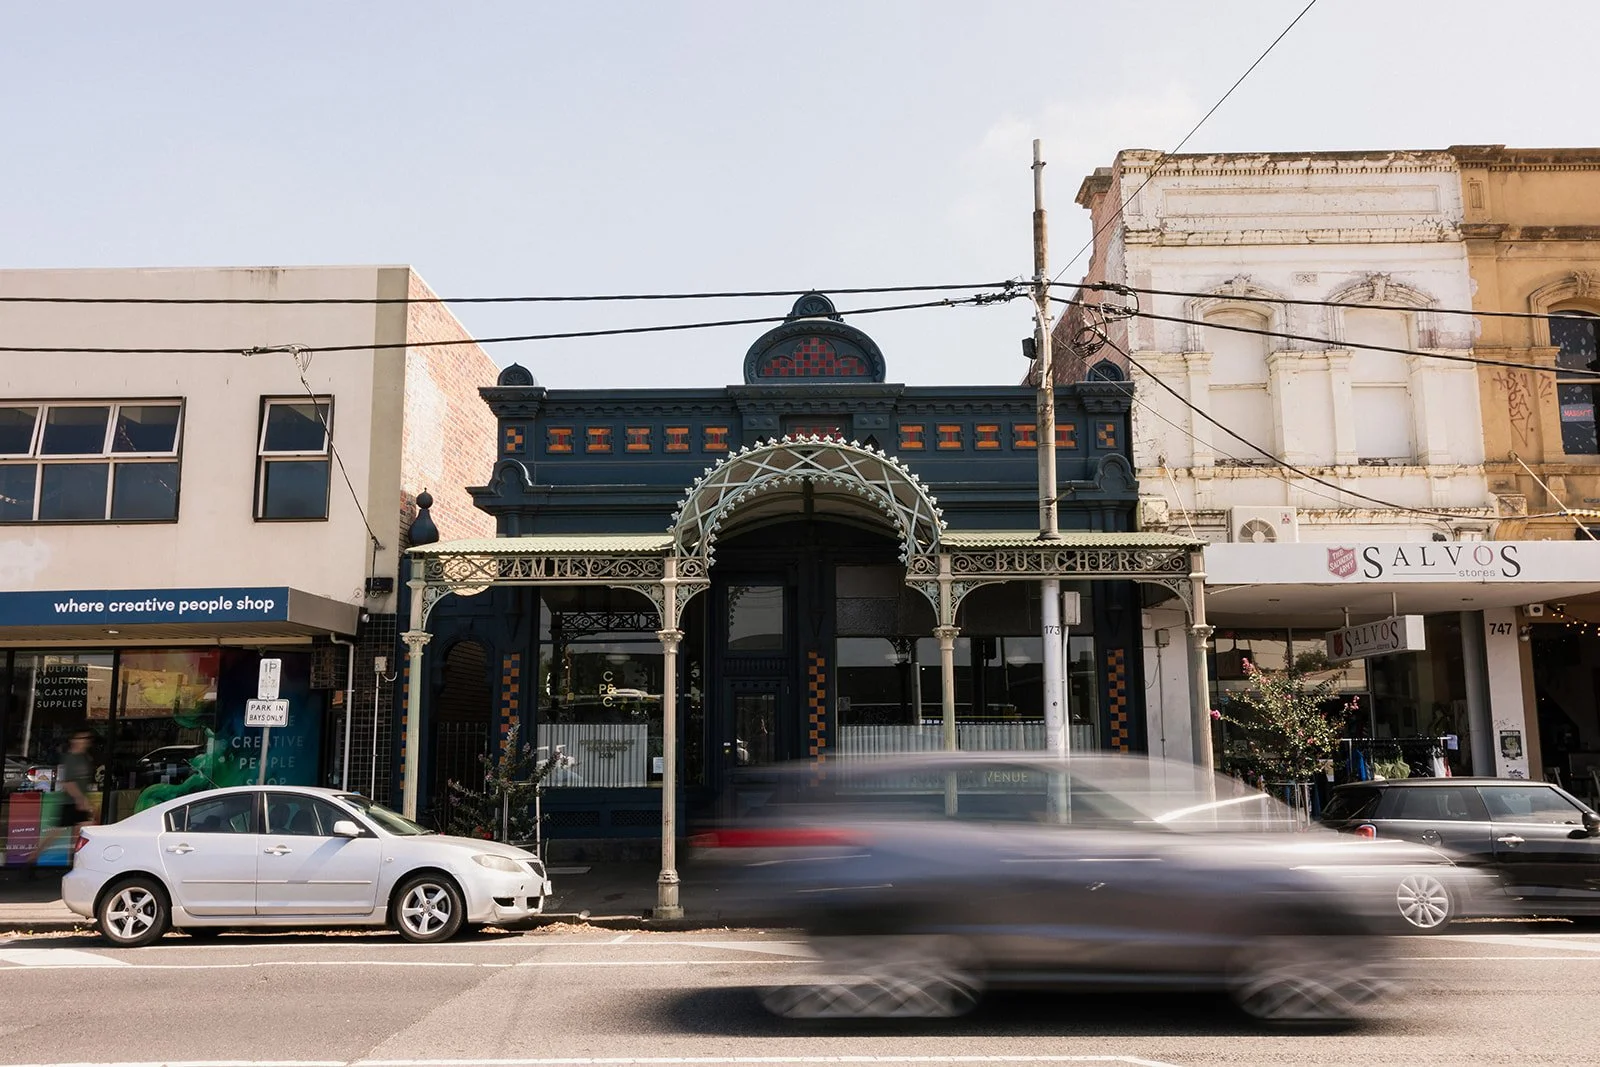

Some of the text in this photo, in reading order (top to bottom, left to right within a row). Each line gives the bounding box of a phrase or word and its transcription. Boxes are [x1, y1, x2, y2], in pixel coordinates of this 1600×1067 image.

[994, 551, 1147, 571] BUTCHERS
[1332, 549, 1344, 560] THE
[1362, 545, 1521, 578] SALVOS
[1459, 569, 1496, 577] stores
[54, 596, 275, 615] where creative people shop
[1043, 625, 1061, 635] 173
[1489, 622, 1513, 635] 747
[1344, 621, 1399, 657] SALVOS
[44, 688, 87, 696] CASTING
[37, 700, 83, 708] SUPPLIES
[232, 735, 303, 748] CRETIVE
[240, 756, 296, 769] PEPLE
[985, 770, 1028, 783] VENUE
